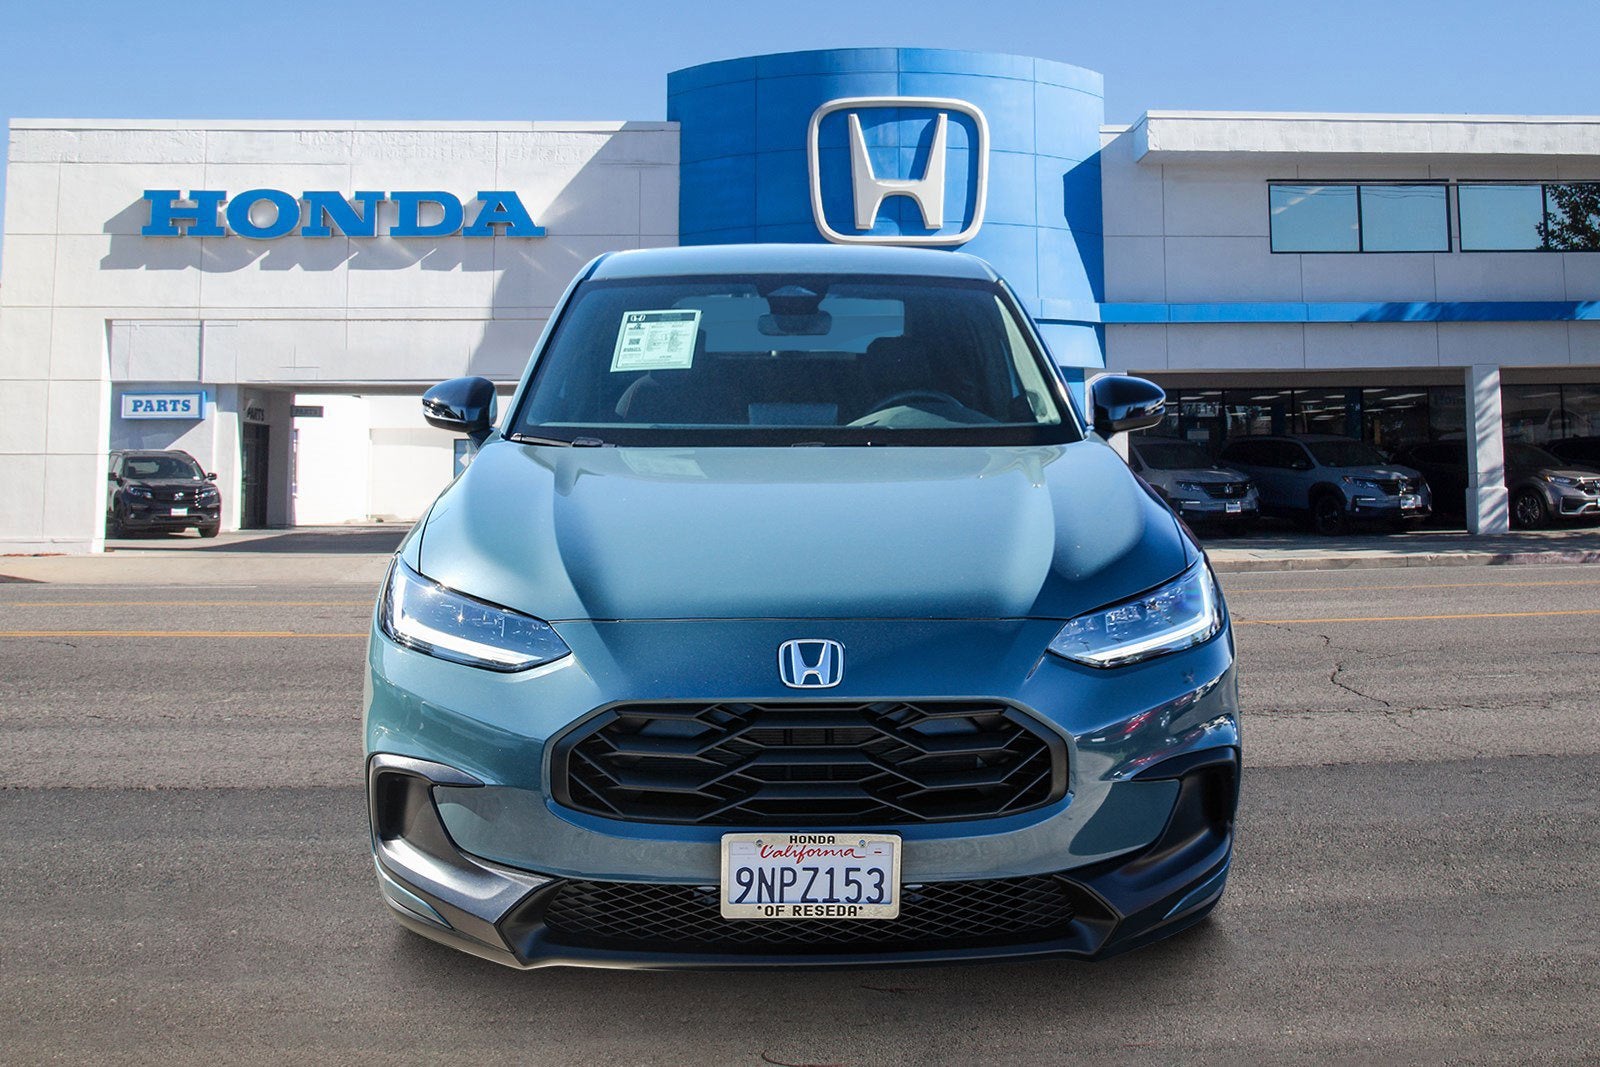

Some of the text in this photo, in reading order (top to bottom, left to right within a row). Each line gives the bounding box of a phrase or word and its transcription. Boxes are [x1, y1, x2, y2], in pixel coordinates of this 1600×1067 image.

[142, 188, 547, 239] HONDA
[132, 399, 192, 412] PARTS
[789, 835, 835, 844] HONDA
[760, 844, 866, 864] California
[735, 866, 885, 904] 9NPZ153
[764, 906, 858, 917] OF RESEDA
